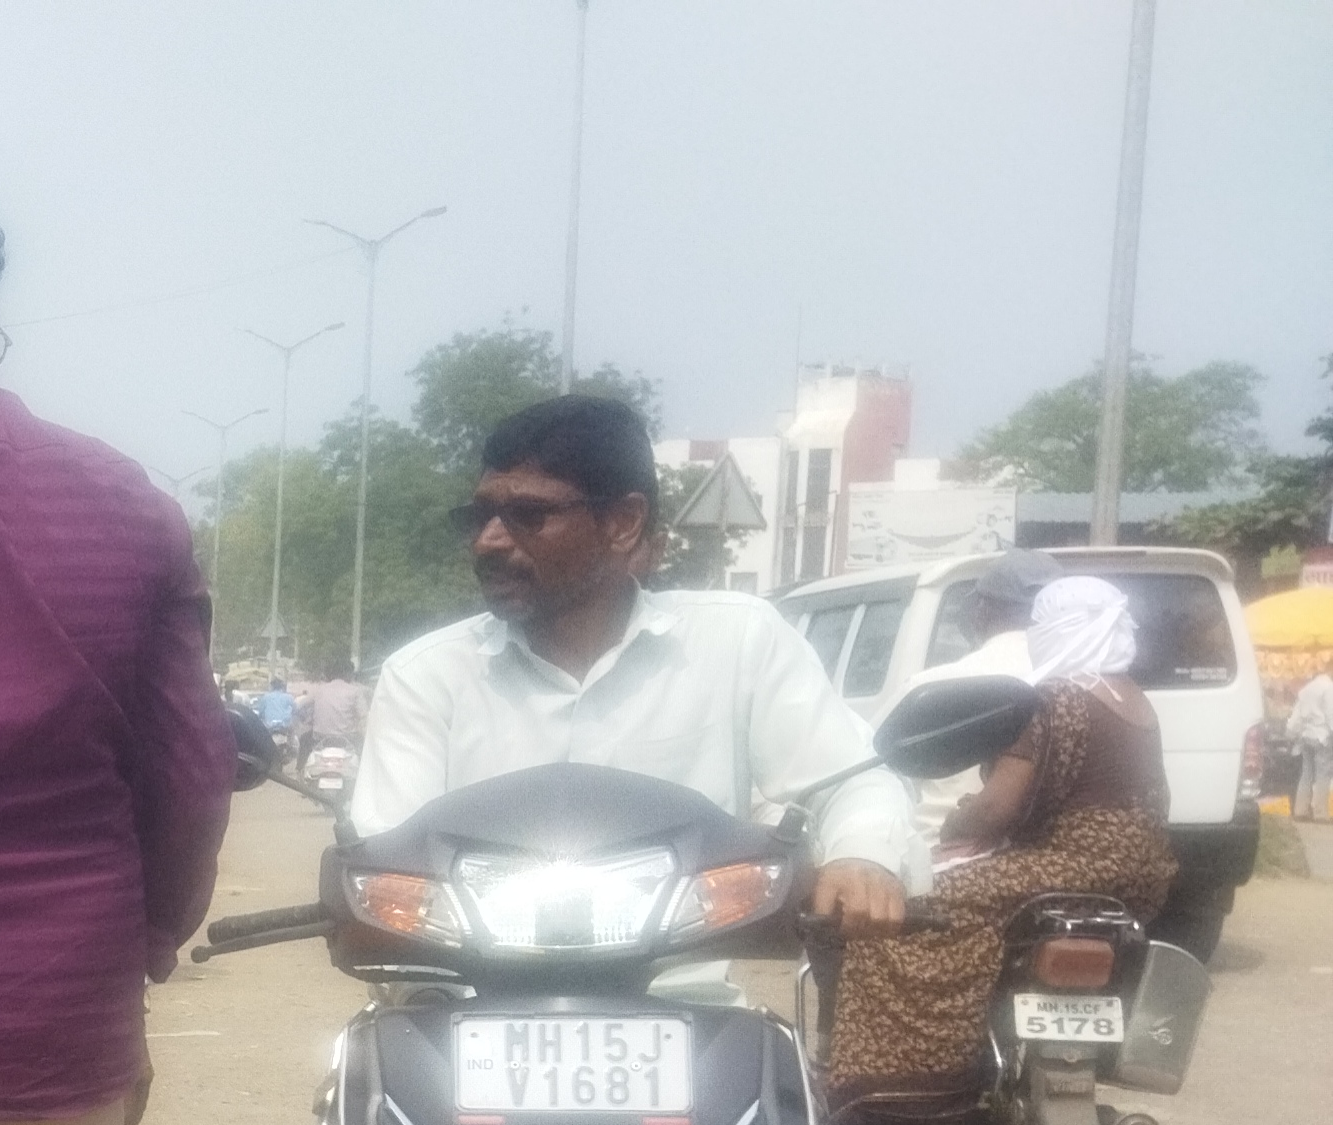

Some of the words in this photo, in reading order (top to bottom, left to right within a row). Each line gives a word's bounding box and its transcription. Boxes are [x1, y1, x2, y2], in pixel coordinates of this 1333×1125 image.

[1026, 1016, 1115, 1036] 5178
[467, 1059, 494, 1070] IND
[505, 1065, 660, 1108] V1681
